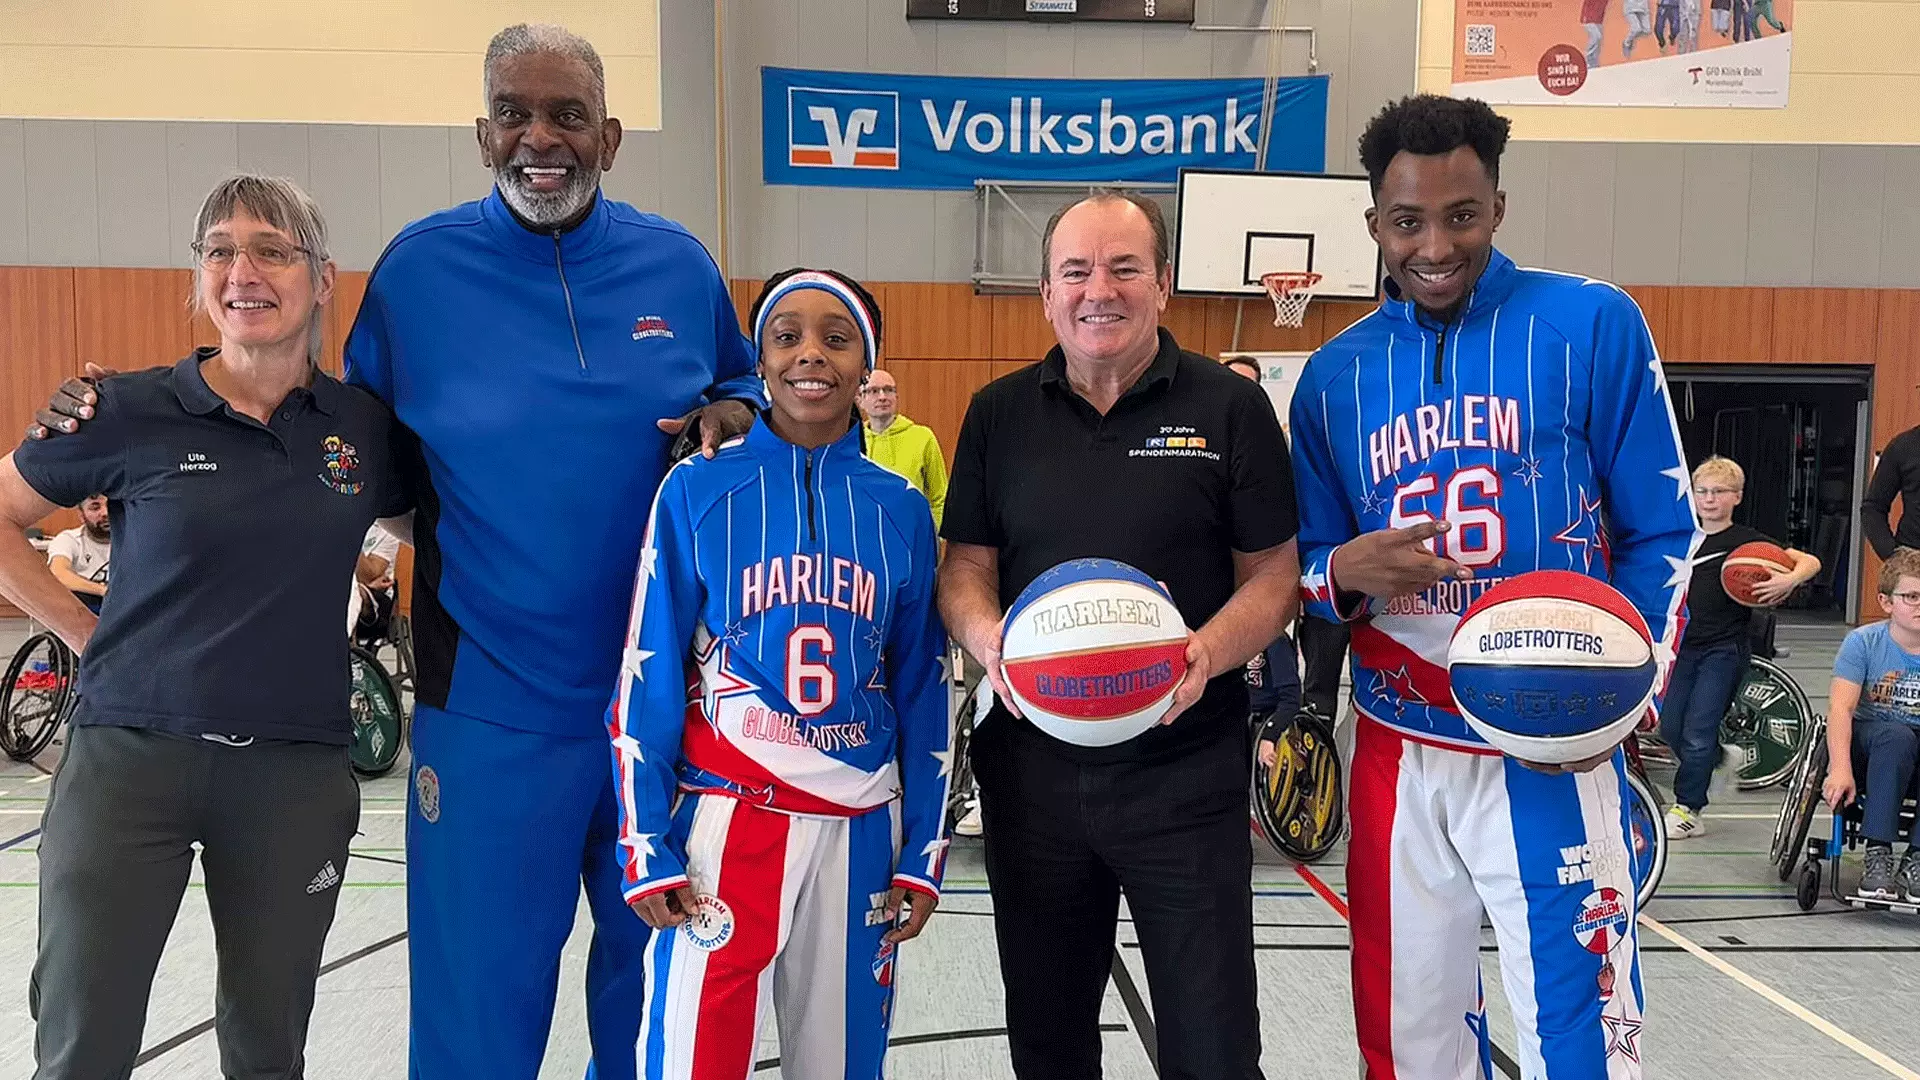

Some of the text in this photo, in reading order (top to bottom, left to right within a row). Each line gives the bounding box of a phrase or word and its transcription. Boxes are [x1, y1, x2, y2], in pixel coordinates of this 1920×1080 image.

[1555, 53, 1570, 63] WIR
[1547, 63, 1579, 76] SIND FÜR
[920, 97, 1258, 155] Volksbank
[1173, 426, 1196, 434] Jahre
[1369, 394, 1520, 486] HARLEM
[187, 453, 206, 462] Ute
[1128, 449, 1220, 460] SPENDENMARATHON
[179, 462, 217, 472] Herzog
[742, 553, 876, 622] HARLEM
[1033, 598, 1161, 637] HARLEM
[785, 623, 838, 718] 6
[1036, 659, 1172, 699] GLOBETROTTERS
[1872, 683, 1885, 694] AT
[1585, 902, 1621, 922] HARLEM
